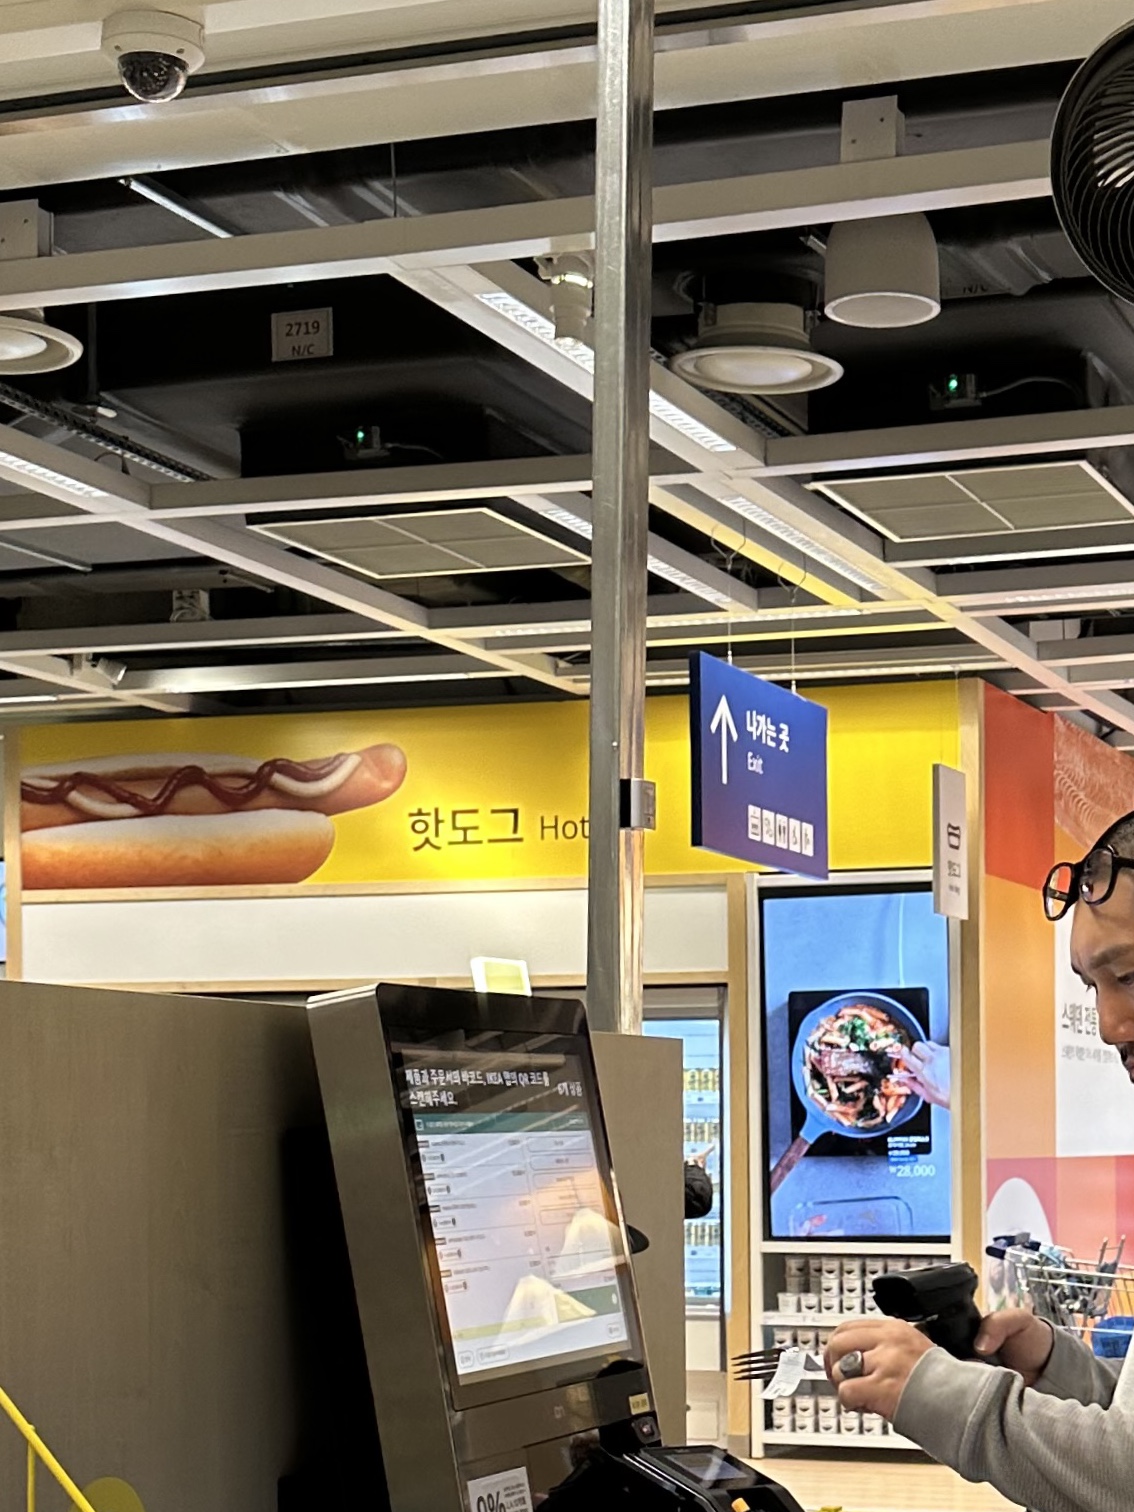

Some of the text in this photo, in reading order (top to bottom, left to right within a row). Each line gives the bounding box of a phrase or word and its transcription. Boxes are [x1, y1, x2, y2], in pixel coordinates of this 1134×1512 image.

[285, 321, 320, 337] 2719
[291, 344, 315, 357] N/C
[746, 710, 790, 753] 나가는 곳
[747, 752, 763, 774] Exit
[408, 807, 589, 851] 핫도그 Hot
